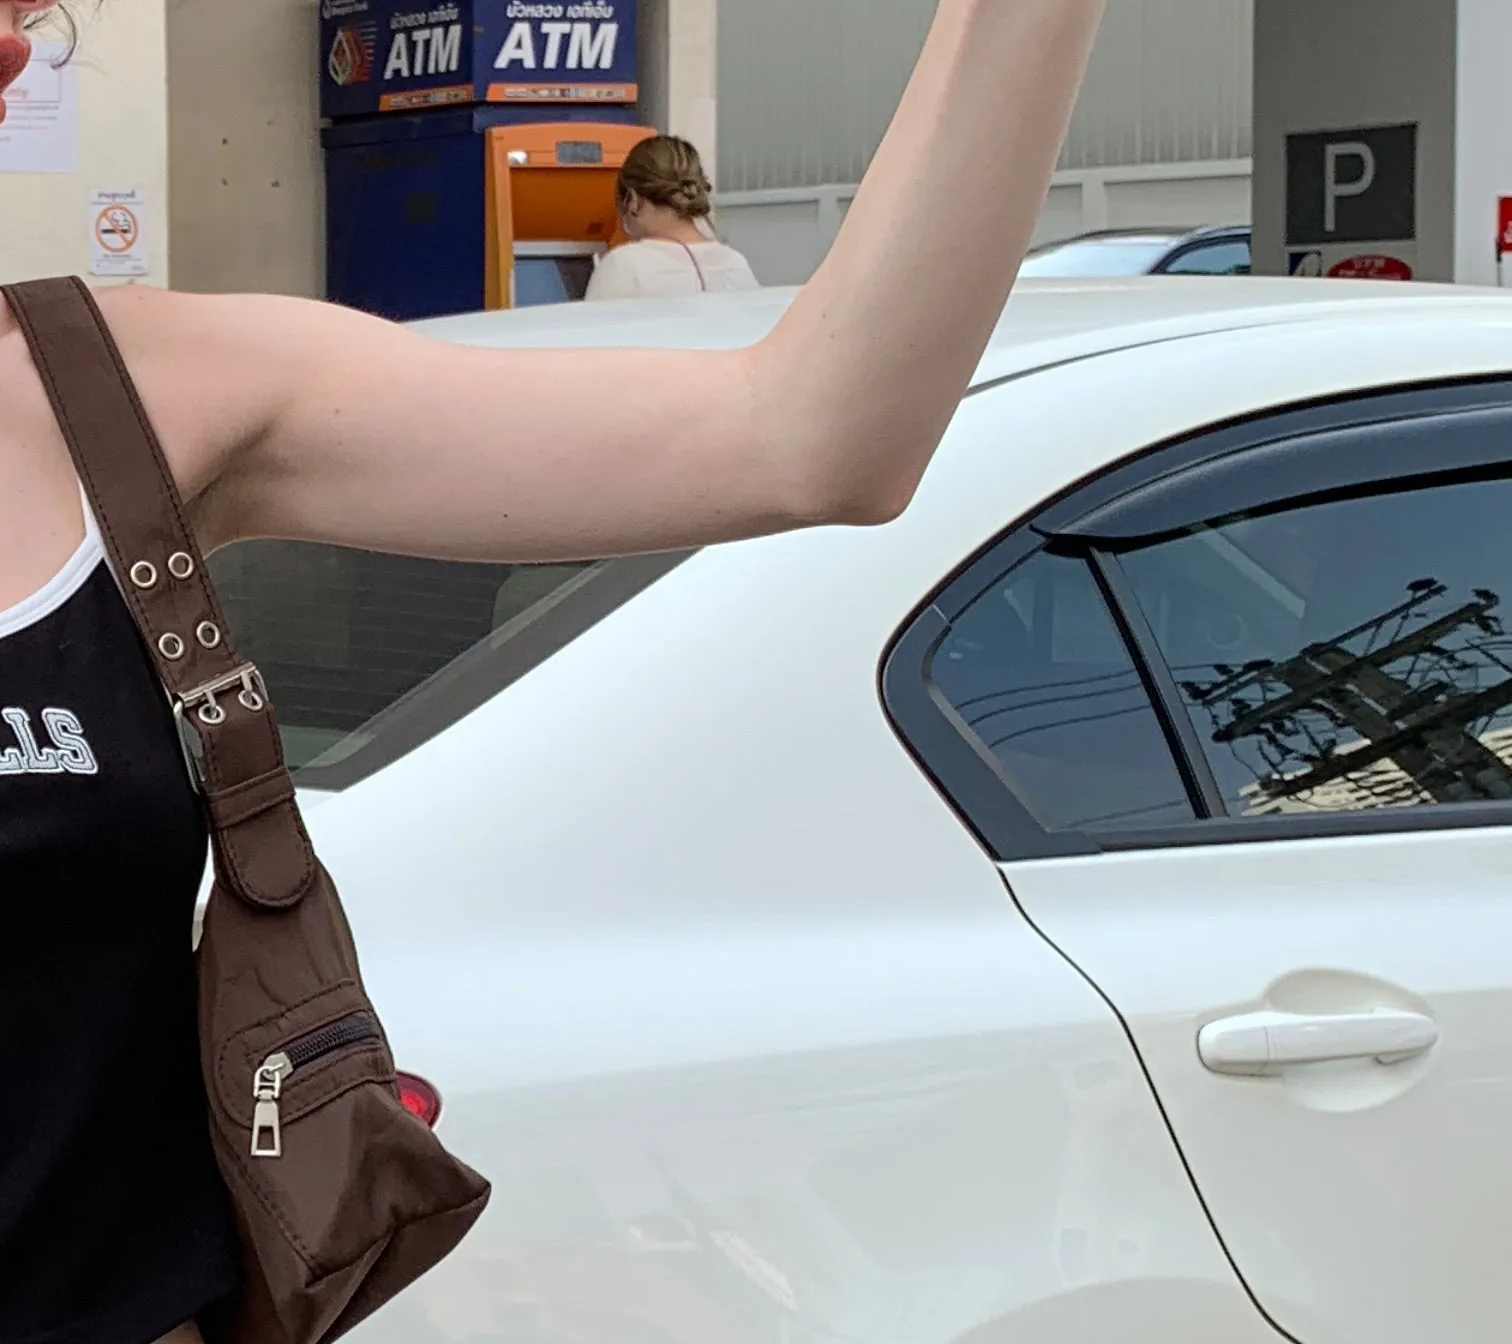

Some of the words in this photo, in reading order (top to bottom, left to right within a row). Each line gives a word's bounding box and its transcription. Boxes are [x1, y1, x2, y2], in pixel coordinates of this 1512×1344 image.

[384, 24, 463, 80] ATM
[493, 21, 619, 70] ATM
[1324, 141, 1376, 233] P
